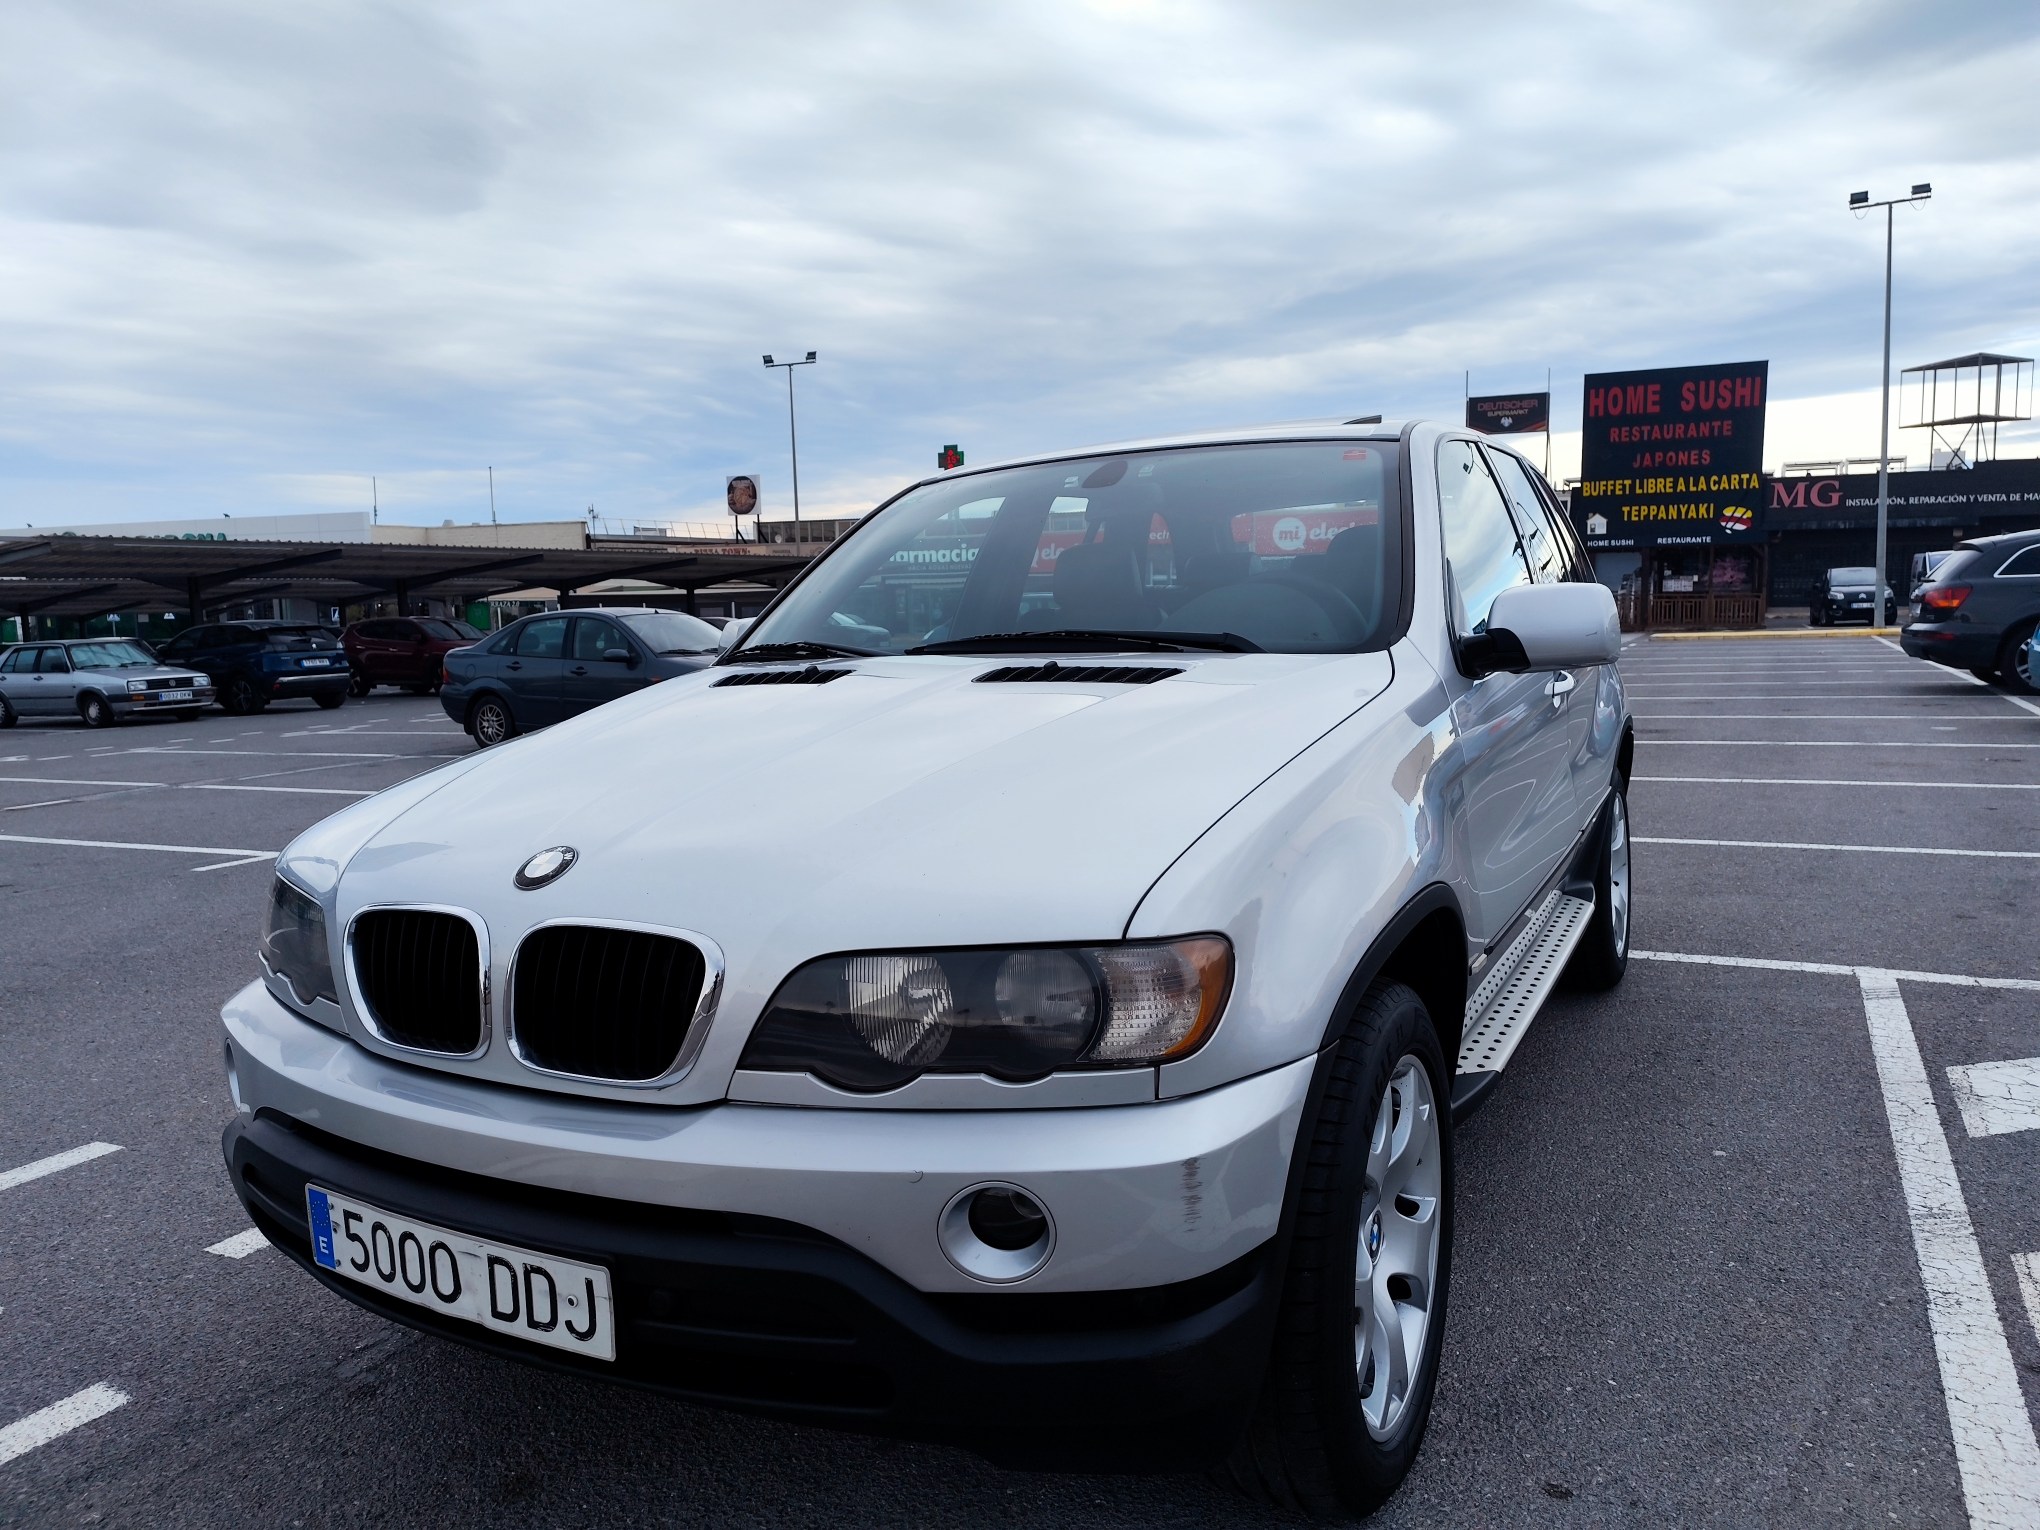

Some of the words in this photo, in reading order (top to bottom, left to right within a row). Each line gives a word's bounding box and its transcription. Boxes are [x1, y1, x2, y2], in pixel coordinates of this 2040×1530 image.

[1477, 399, 1538, 411] DEUTSCHER
[1588, 383, 1661, 417] HOME
[1680, 376, 1762, 412] SUSHI
[1487, 408, 1529, 417] SUPERMARKT
[1609, 420, 1733, 443] RESTAURANTE
[1632, 449, 1711, 468] JAPONES
[1582, 479, 1632, 496] BUFFET
[1635, 477, 1674, 494] LIBRE
[1676, 476, 1686, 492] A
[1689, 476, 1707, 492] LA
[1709, 473, 1760, 491] CARTA
[1769, 480, 1843, 509] MG
[1845, 496, 1907, 507] INSTALAIÓN,
[1908, 493, 1967, 505] REPARACIÓN
[1968, 494, 1976, 503] Y
[1976, 493, 2007, 502] VENTA
[2009, 493, 2021, 501] DE
[2023, 492, 2040, 501] MA
[1621, 503, 1714, 522] TEPPANYAKI
[1278, 527, 1300, 542] mi
[1610, 539, 1634, 547] SUSHI
[1656, 536, 1712, 545] RESTAURANTE
[889, 543, 980, 564] armacia
[318, 1236, 329, 1254] E
[342, 1208, 462, 1304] 5000
[486, 1253, 597, 1342] DDJ
